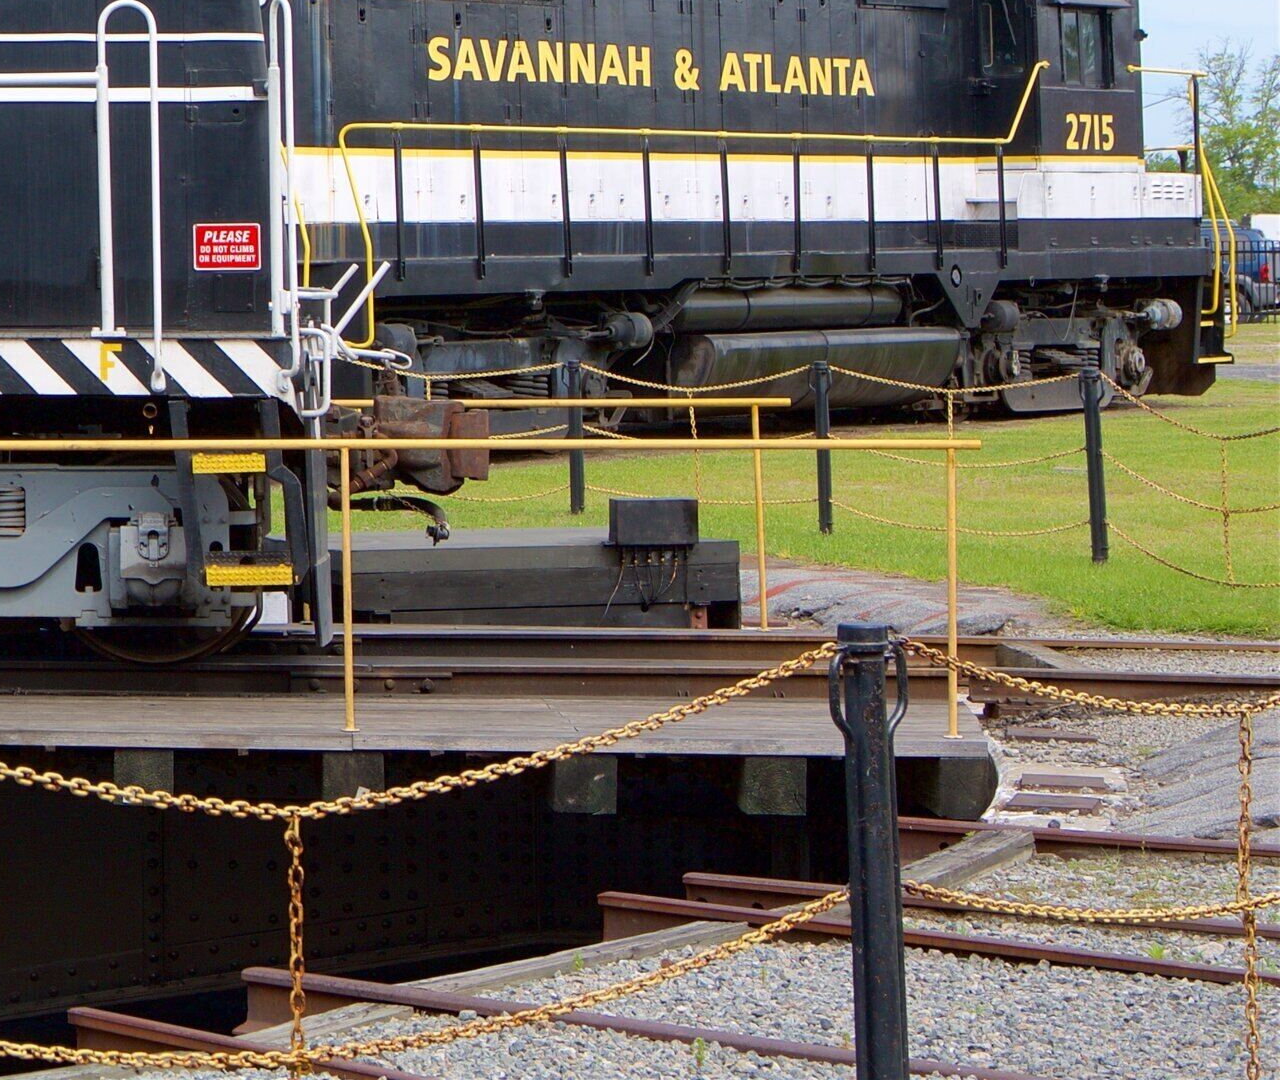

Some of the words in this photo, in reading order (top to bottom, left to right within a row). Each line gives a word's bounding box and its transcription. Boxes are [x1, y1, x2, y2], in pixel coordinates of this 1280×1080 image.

[427, 37, 651, 87] SAVANNAH
[674, 49, 699, 91] &
[720, 52, 875, 97] ATLANTA
[1066, 113, 1115, 151] 2715
[203, 230, 251, 243] PLEASE
[199, 255, 210, 263] ON
[212, 255, 257, 264] EQUIPMENT
[200, 245, 211, 253] DO
[213, 245, 228, 254] NOT
[230, 245, 255, 254] CLIMB
[100, 343, 122, 382] F
